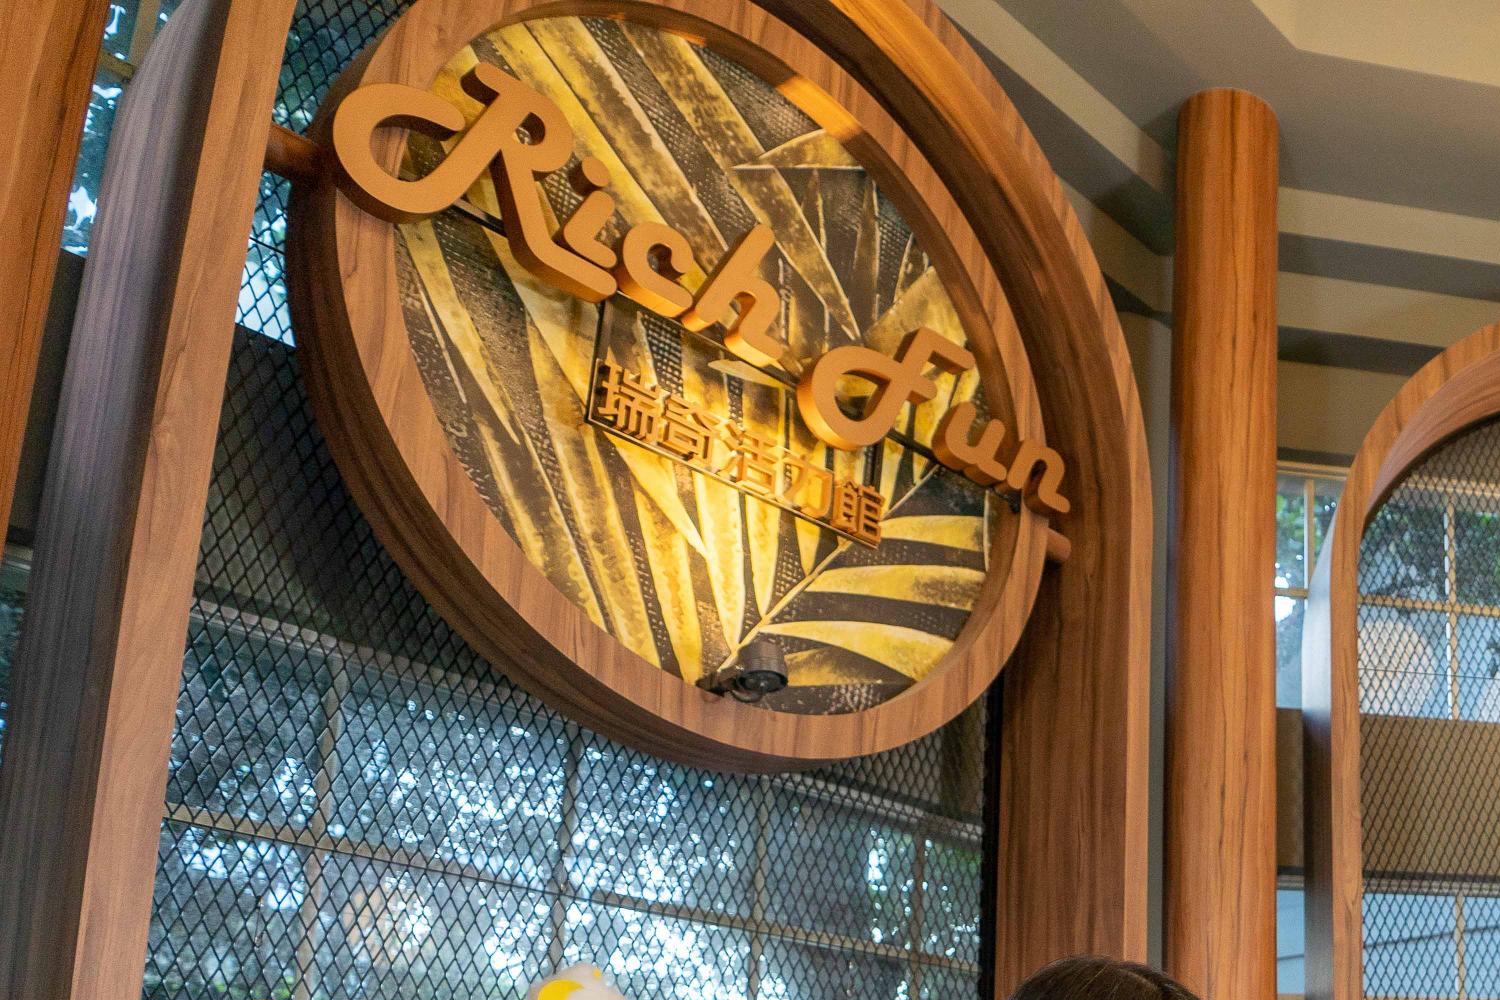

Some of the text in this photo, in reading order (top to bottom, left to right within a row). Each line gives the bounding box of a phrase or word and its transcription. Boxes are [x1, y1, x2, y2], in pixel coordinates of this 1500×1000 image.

[332, 63, 1071, 516] Rich Fun
[598, 362, 884, 544] 瑞奇活力館
